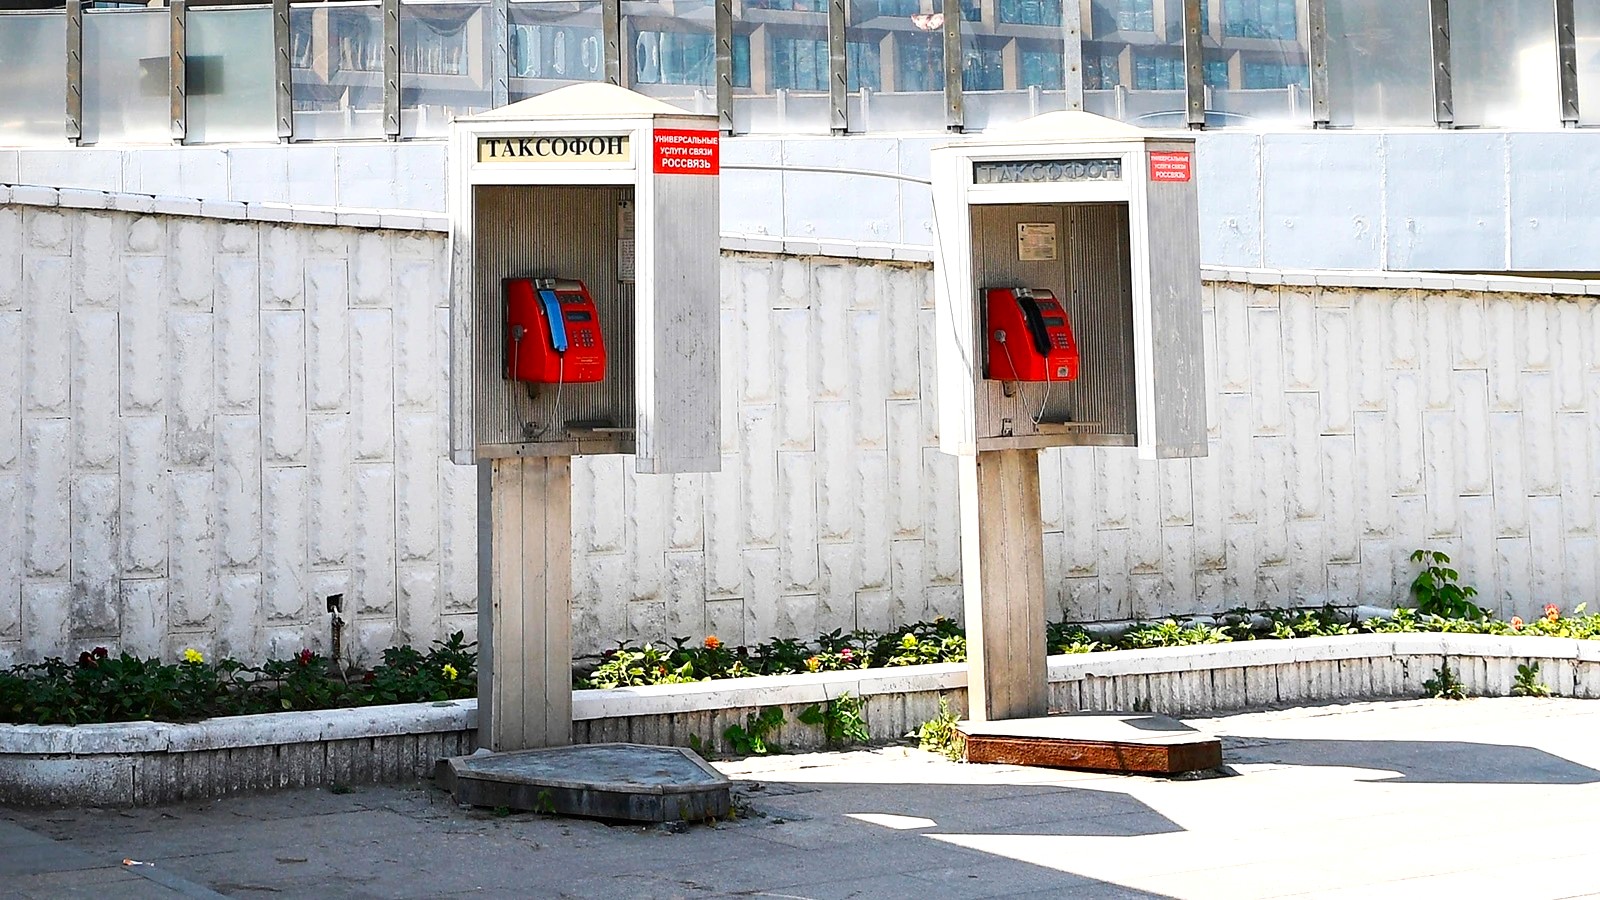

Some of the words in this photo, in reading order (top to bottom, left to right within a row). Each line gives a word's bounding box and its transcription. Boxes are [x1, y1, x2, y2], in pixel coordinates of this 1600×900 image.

[654, 135, 719, 145] УНИВЕРСАЛЬНЫЕ
[486, 136, 623, 157] ТАКСОФОН
[660, 147, 687, 156] УСЛУГИ
[688, 147, 713, 156] СВЯЗИ
[661, 158, 711, 169] РОССВЯЗЬ
[980, 160, 1120, 183] ТАКСОФОН
